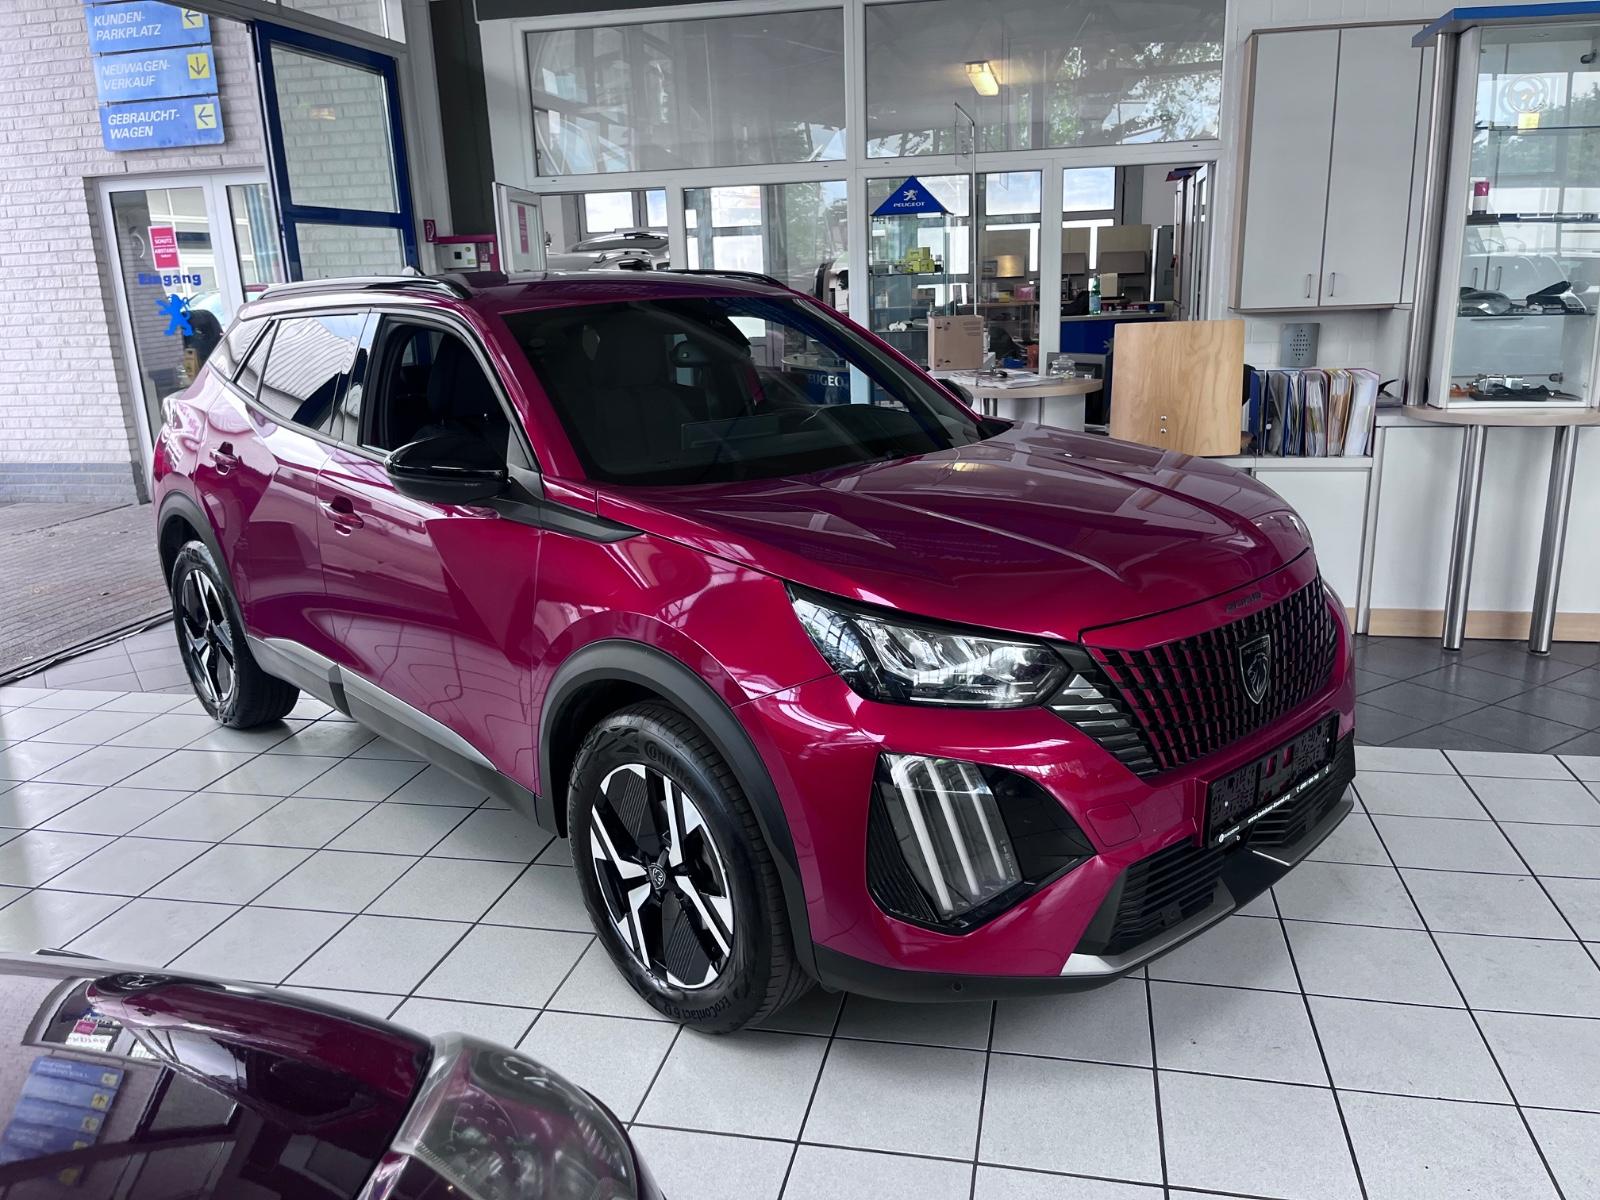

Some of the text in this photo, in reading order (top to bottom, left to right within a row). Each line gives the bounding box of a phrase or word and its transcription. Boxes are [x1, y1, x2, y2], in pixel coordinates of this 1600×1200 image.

[94, 11, 145, 26] KUNDEN-
[96, 24, 161, 41] PARKPLATZ
[101, 60, 170, 75] NEUWAGEN-
[103, 75, 156, 90] VERKAUF
[108, 109, 180, 125] GEBRAUCHT-
[110, 126, 153, 139] WAGEN
